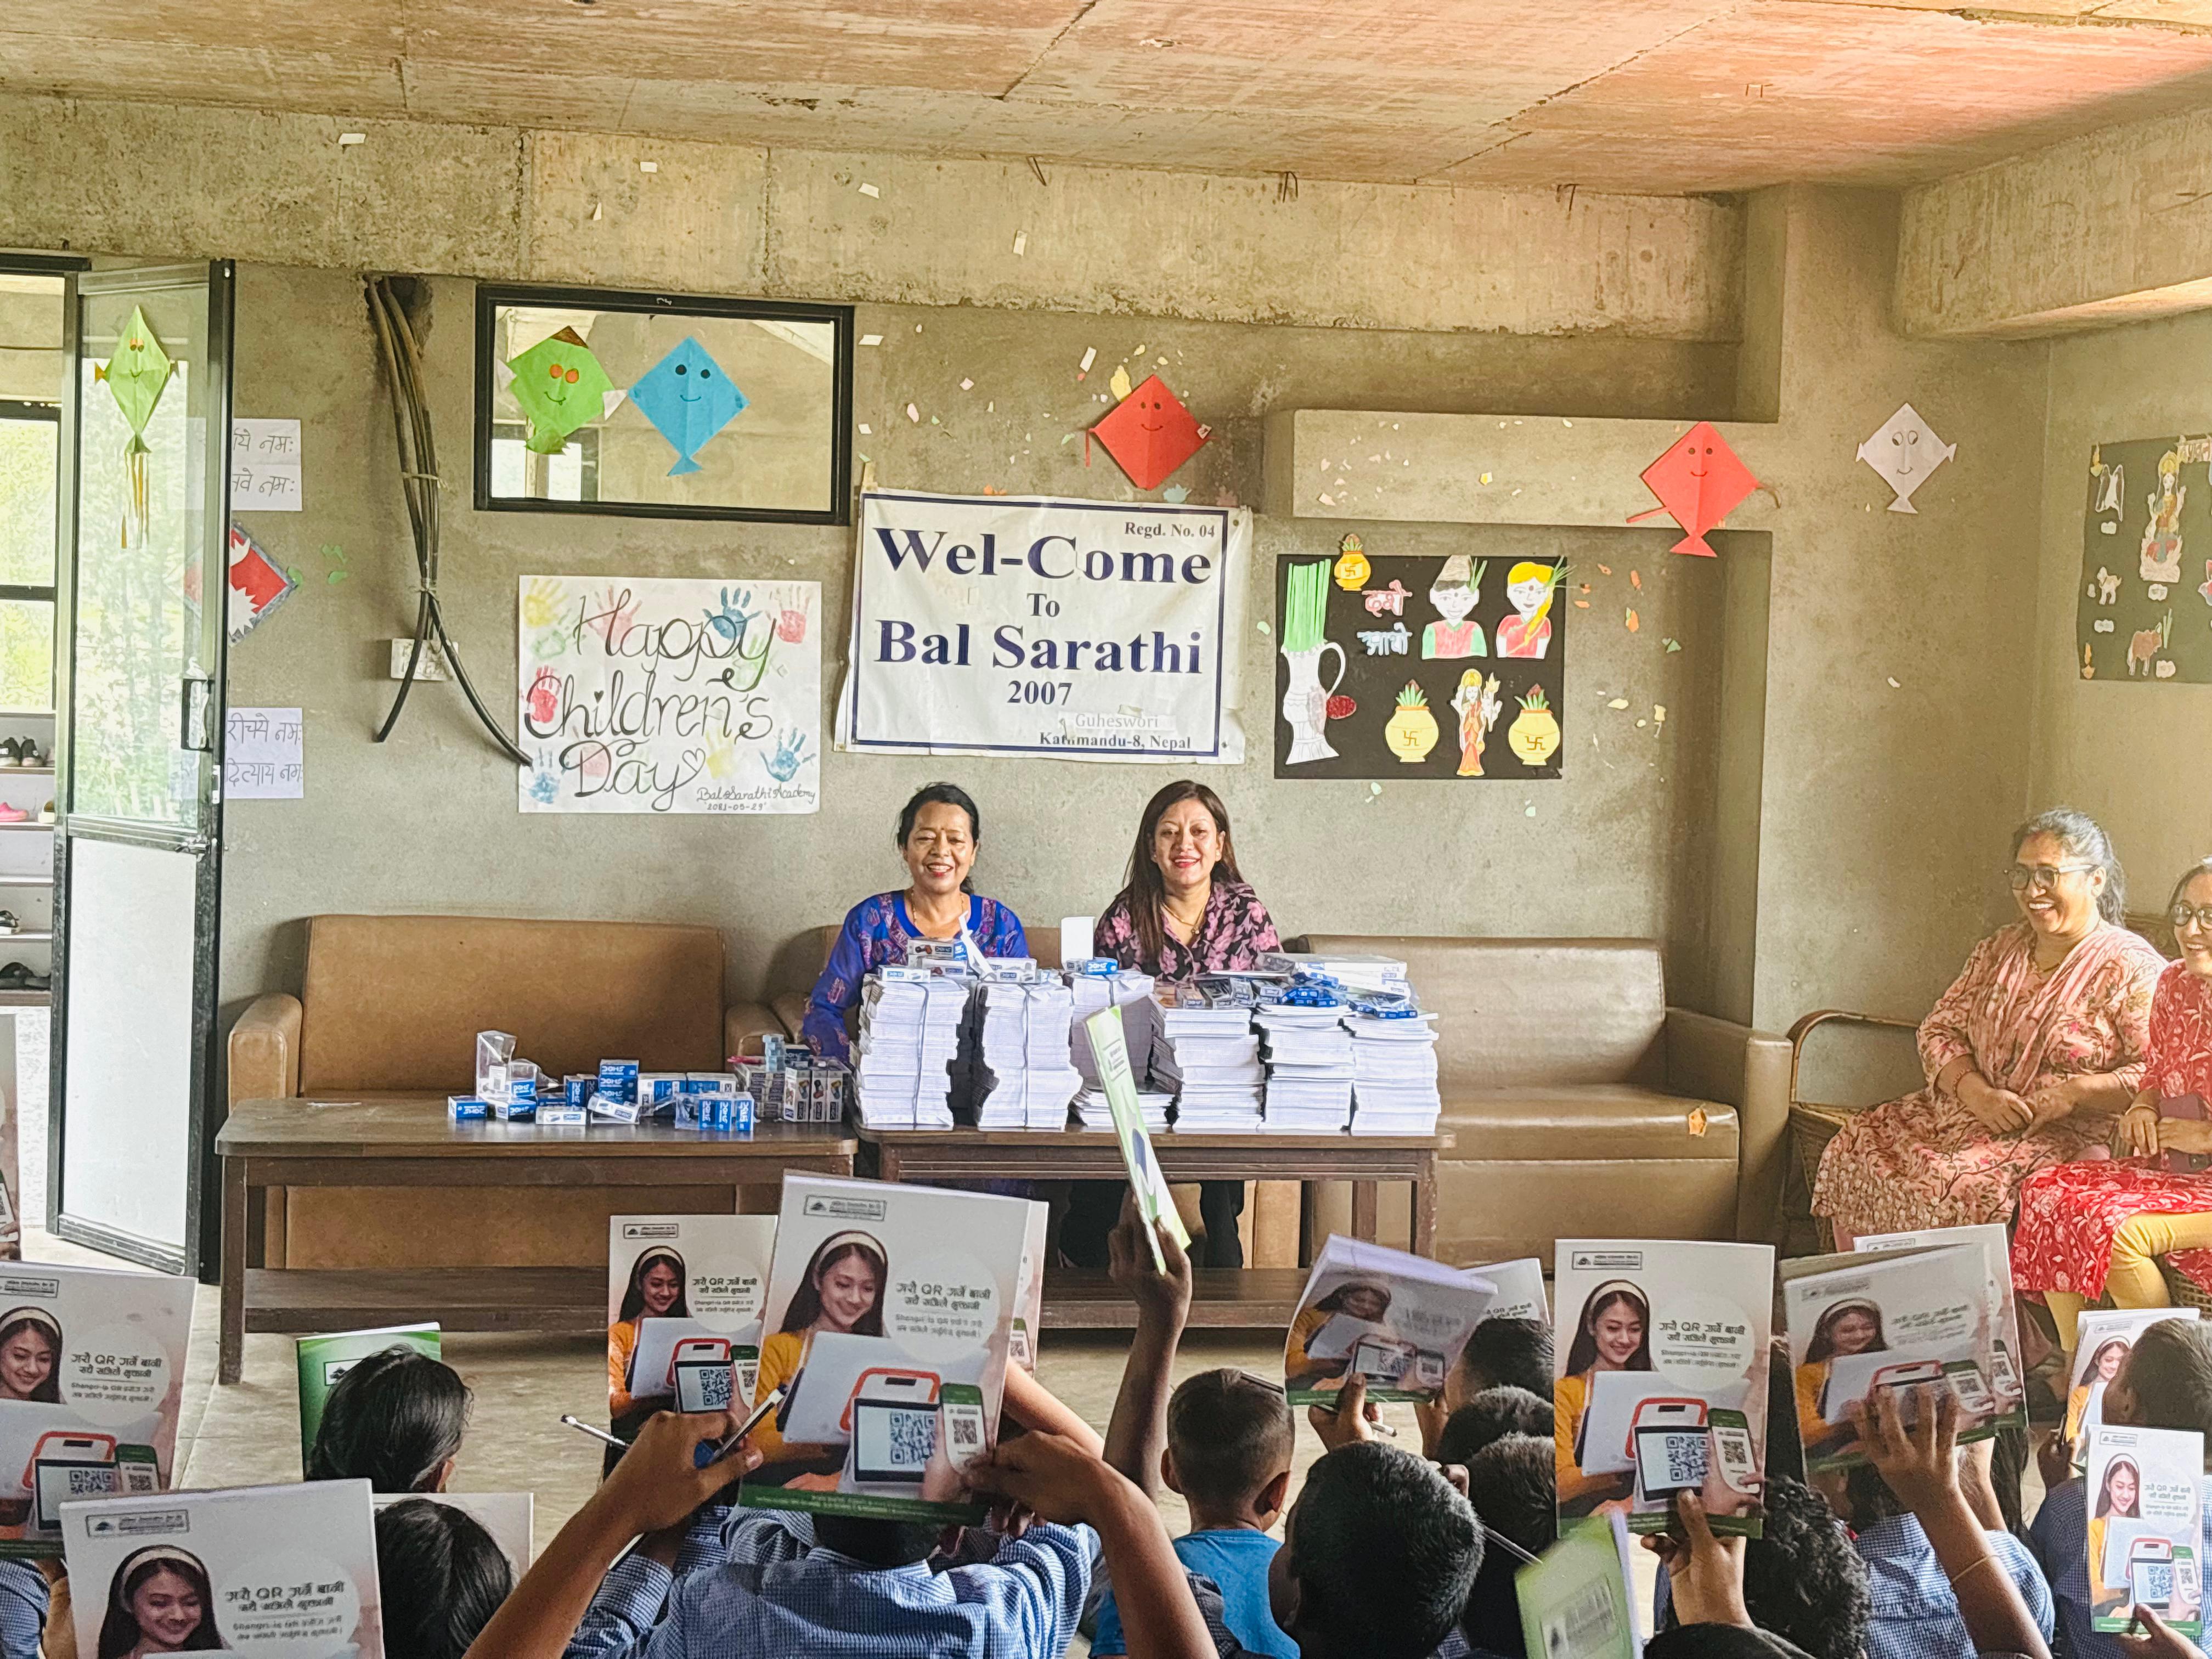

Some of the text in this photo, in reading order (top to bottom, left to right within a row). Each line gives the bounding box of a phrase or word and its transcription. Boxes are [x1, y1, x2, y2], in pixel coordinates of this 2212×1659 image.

[1124, 521, 1215, 538] Regd. No. 04
[872, 527, 1212, 584] Wel-Come
[1026, 592, 1060, 617] To
[573, 588, 777, 692] Happy
[874, 619, 1203, 674] Bal Sarathi
[1007, 680, 1073, 705] 2007
[523, 667, 774, 744] Children's
[1075, 713, 1158, 728] Guheswori
[1150, 735, 1190, 751] Nepal
[558, 738, 692, 811] Day
[696, 786, 723, 802] Bal
[922, 1283, 942, 1295] QR
[1681, 1322, 1701, 1331] QR
[95, 1355, 115, 1365] QR
[256, 1587, 283, 1599] QR
